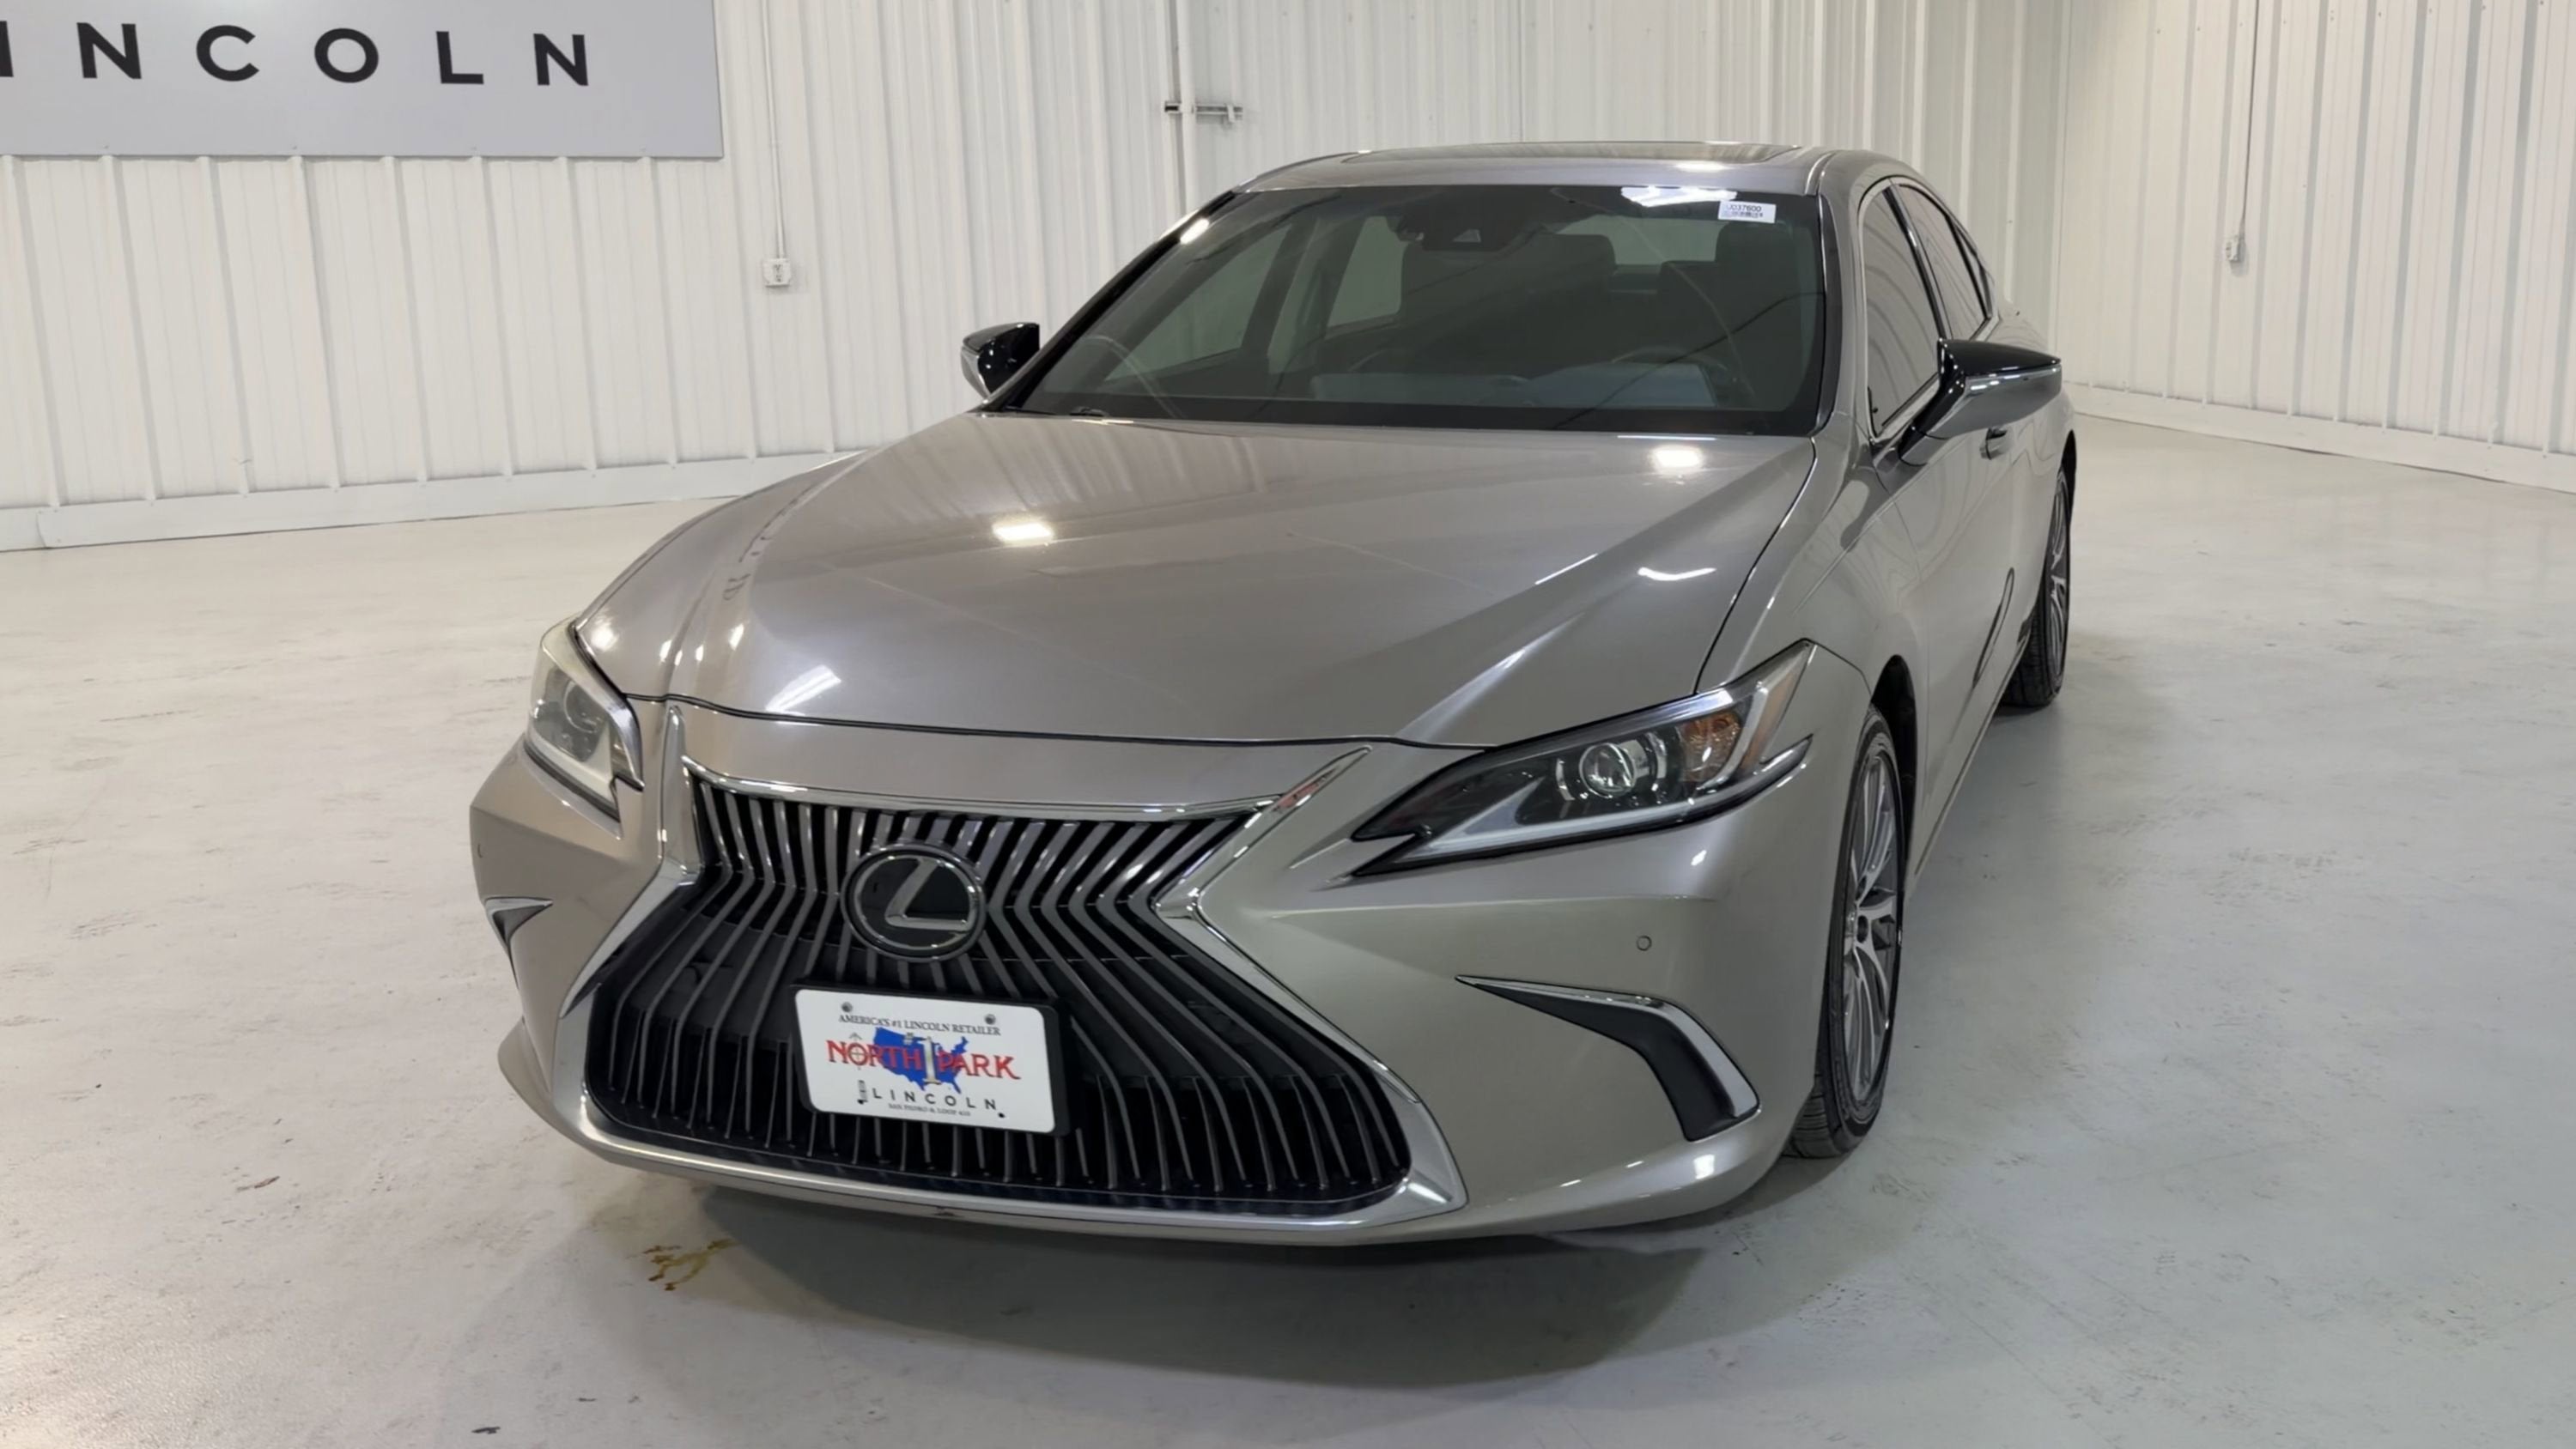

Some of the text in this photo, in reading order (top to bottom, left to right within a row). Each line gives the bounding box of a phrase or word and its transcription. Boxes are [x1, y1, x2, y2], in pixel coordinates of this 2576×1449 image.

[904, 1020, 950, 1032] LINCOLN
[952, 1024, 1001, 1036] RETAILER
[826, 1040, 1022, 1080] NORTH PARK
[872, 1088, 996, 1110] LINCOLN
